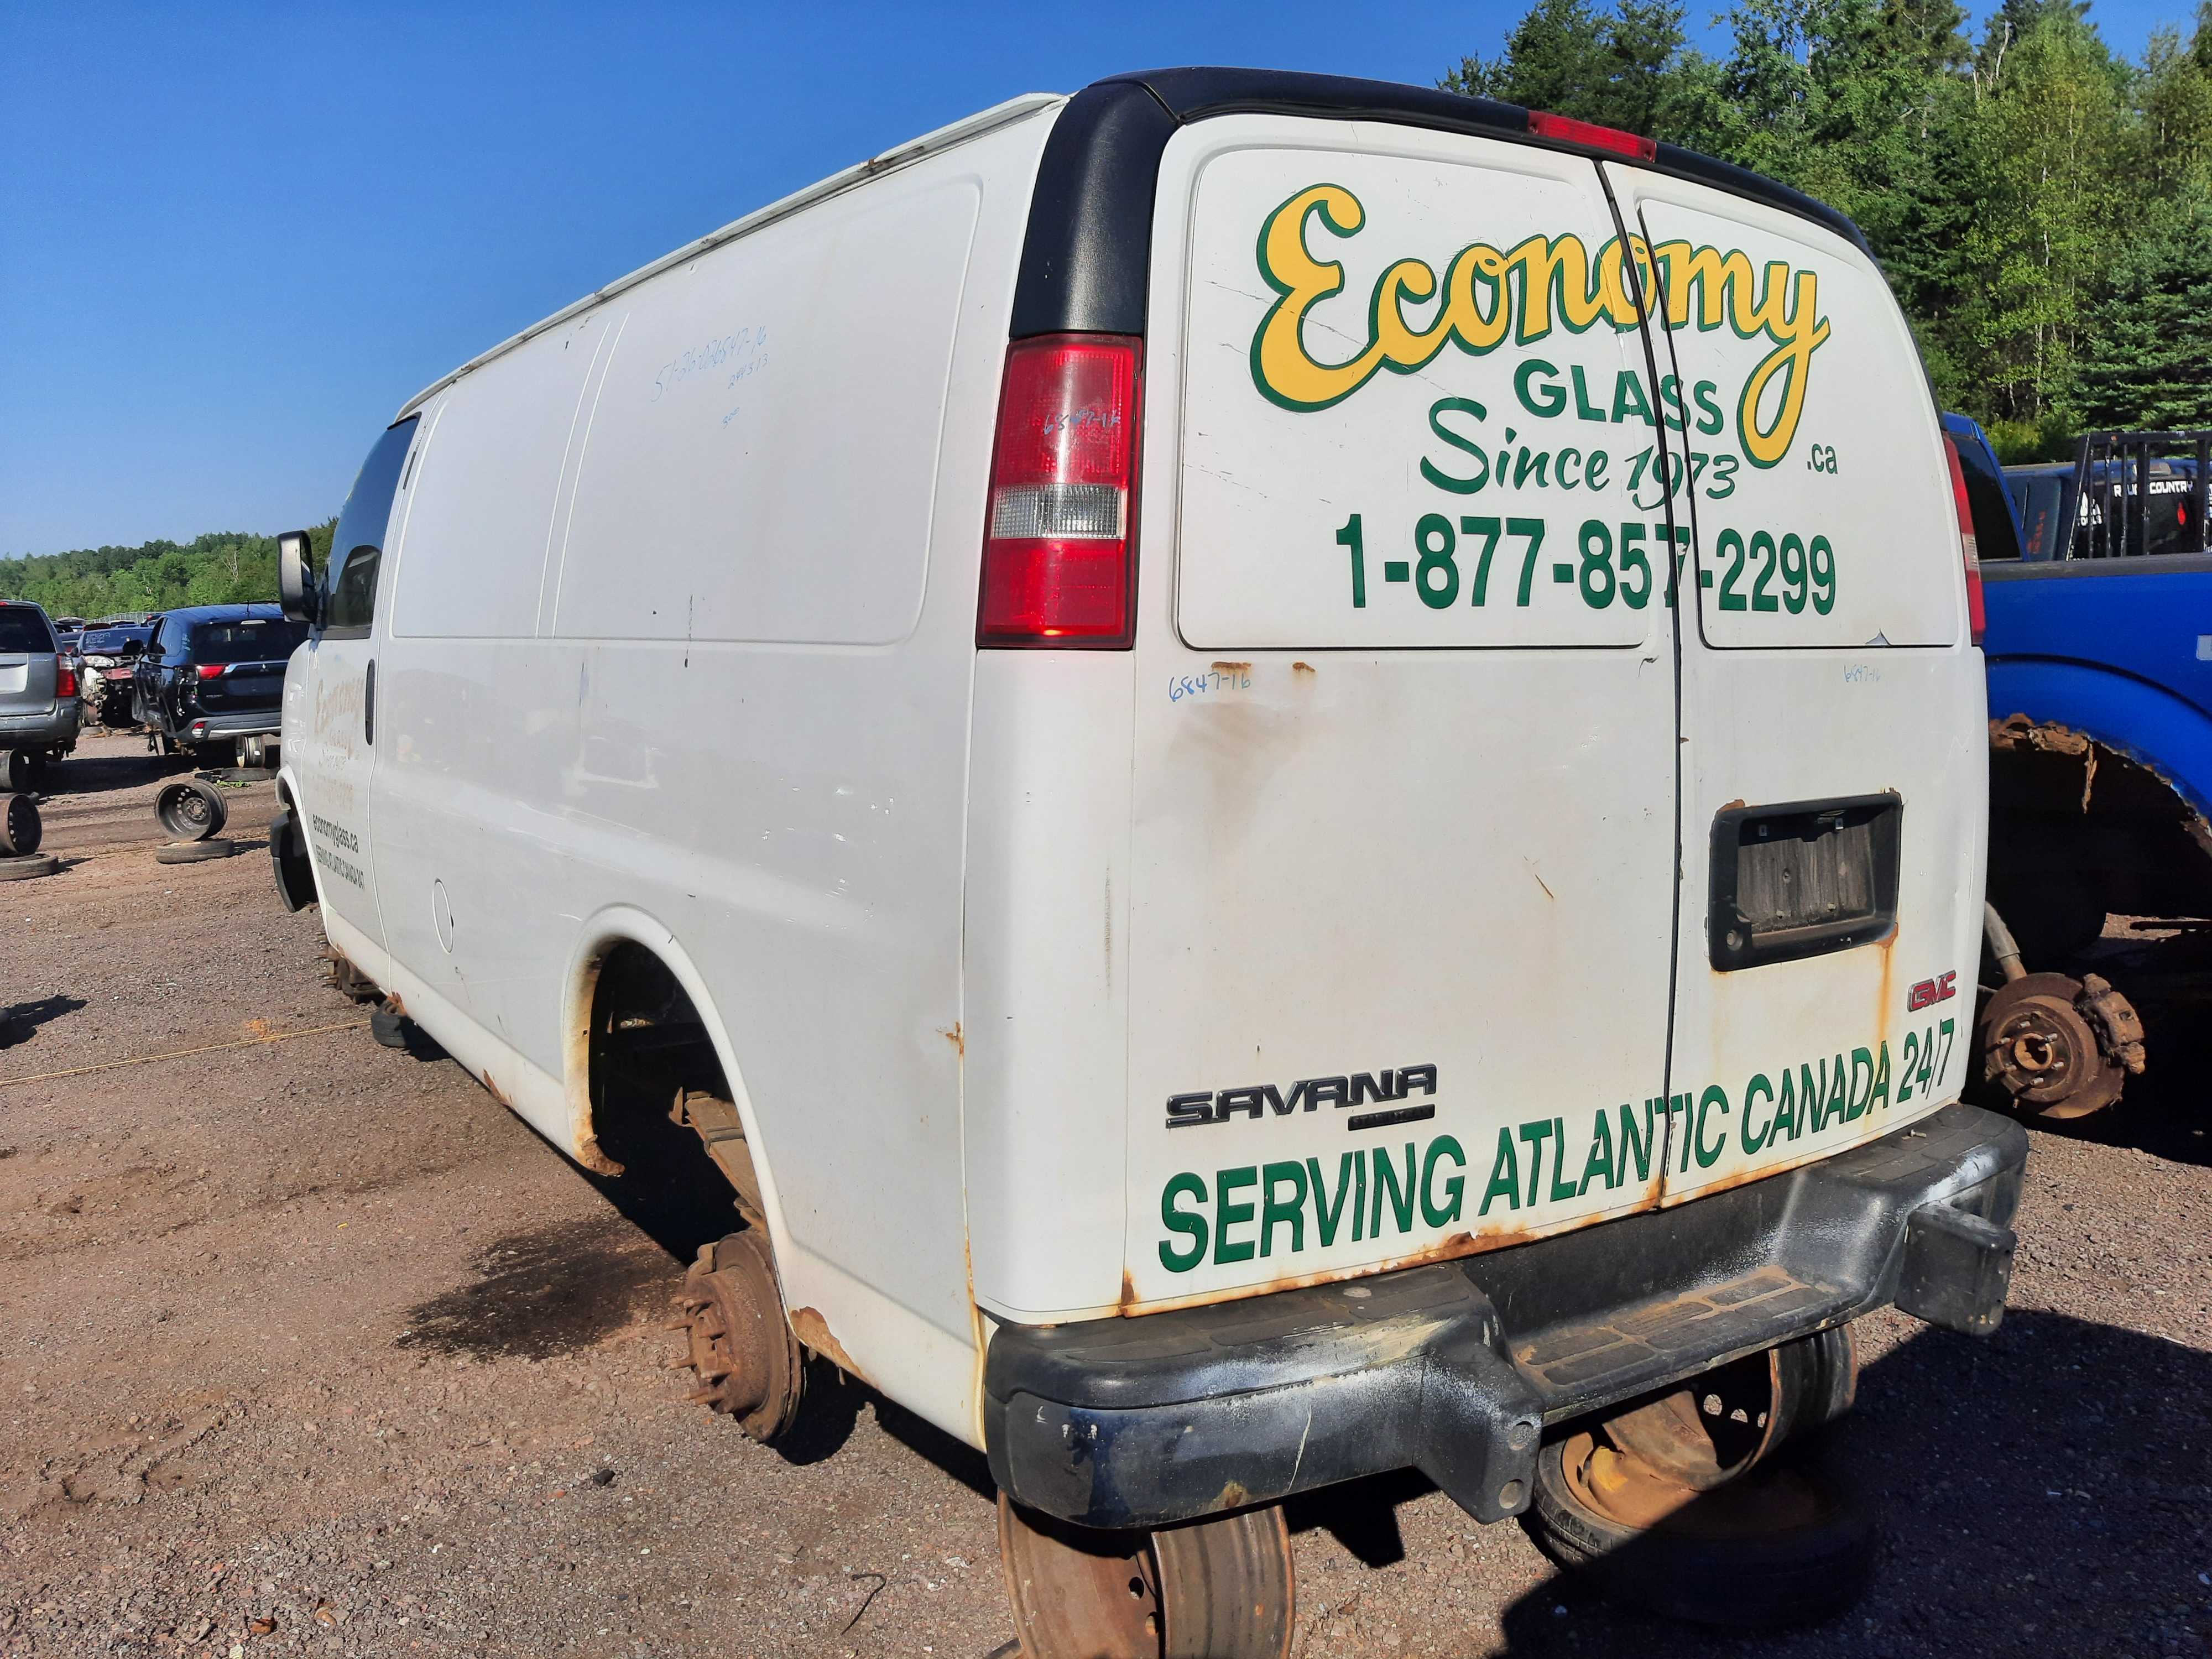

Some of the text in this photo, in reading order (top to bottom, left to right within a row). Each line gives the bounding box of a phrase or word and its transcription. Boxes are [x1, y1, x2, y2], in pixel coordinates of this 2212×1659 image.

[1250, 183, 1830, 469] Economy
[1514, 359, 1724, 435] GLASS
[1420, 398, 1739, 511] Since 1973
[1807, 444, 1838, 474] .ca
[2150, 480, 2193, 495] COUNTRY
[2076, 515, 2103, 526] OLS
[1336, 514, 1836, 615] 1-877-857-2299
[1168, 672, 1251, 702] 6847-16
[312, 814, 359, 853] economyglass.ca
[1907, 969, 1957, 1013] GMC
[1165, 1063, 1437, 1129] SAVANA
[1159, 1018, 1955, 1272] SERVING ATLANTIC CANADA 24/7
